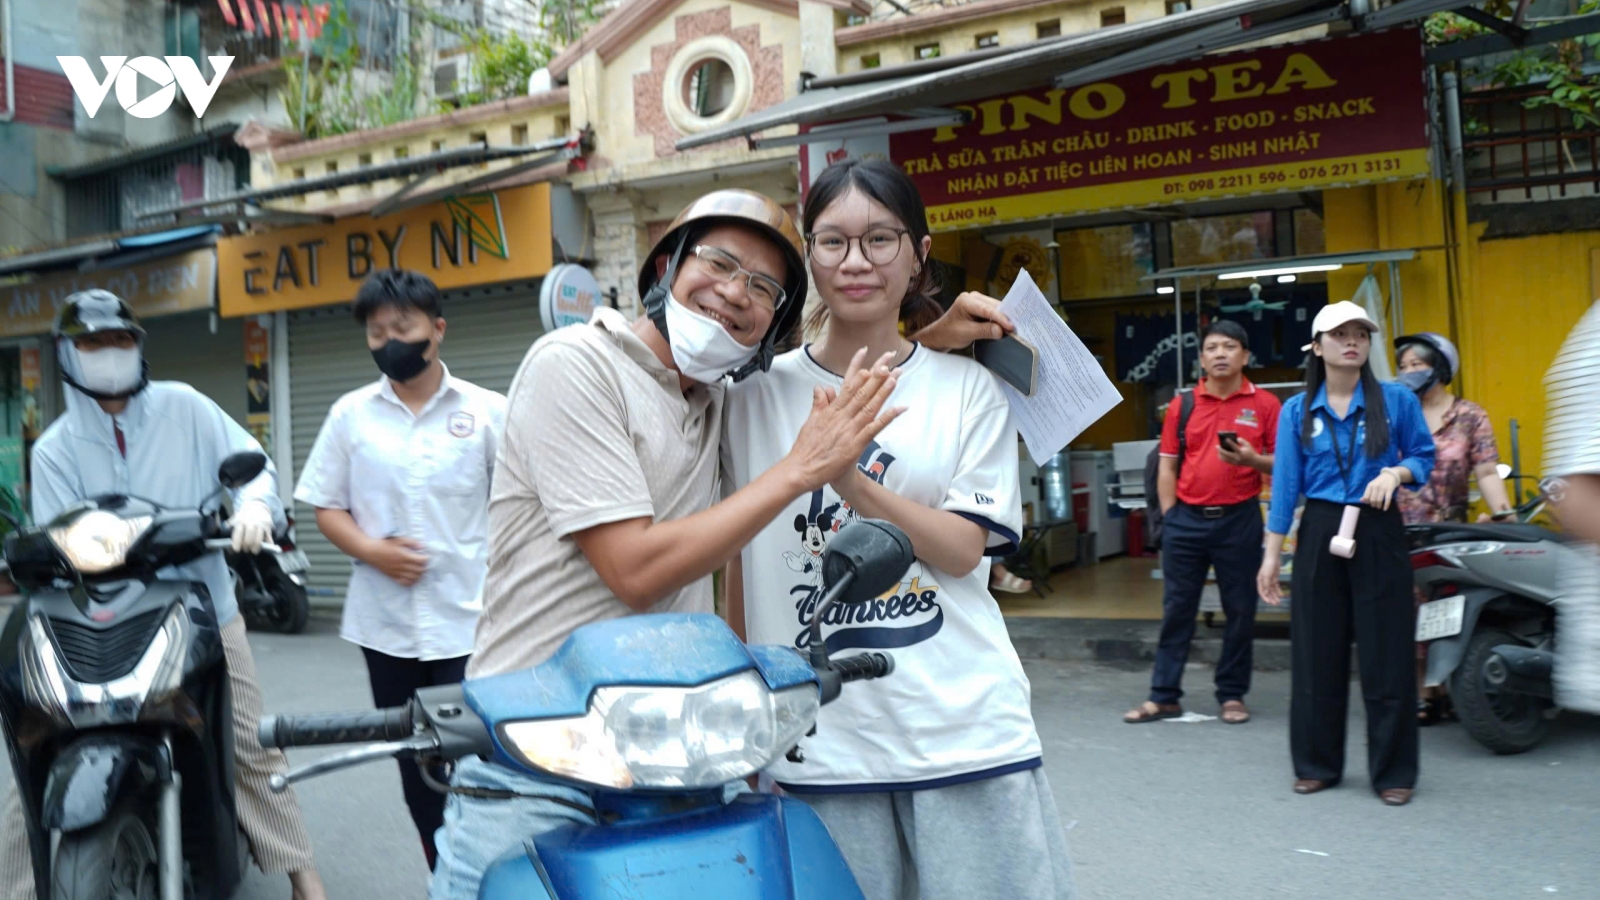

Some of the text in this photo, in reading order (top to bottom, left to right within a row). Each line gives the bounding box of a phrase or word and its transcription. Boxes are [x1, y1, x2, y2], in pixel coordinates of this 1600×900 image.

[1151, 53, 1338, 109] TEA
[903, 152, 943, 176] TRÀ
[947, 148, 987, 169] SỮA
[991, 139, 1047, 163] TRÂN
[1052, 132, 1110, 155] CHÂU
[1127, 120, 1197, 145] DRINK
[1214, 109, 1276, 133] FOOD
[1293, 97, 1376, 123] SNACK
[947, 173, 999, 195] NHẬN
[1003, 166, 1039, 189] ĐẶT
[1044, 160, 1083, 184] TIỆC
[1089, 154, 1127, 176] LIÊN
[1133, 148, 1192, 171] HOAN
[1209, 141, 1257, 161] SINH
[1264, 131, 1321, 155] NHẬT
[1163, 182, 1185, 195] ĐT:
[1188, 178, 1214, 192] 098
[1219, 174, 1253, 188] 2211
[1259, 171, 1286, 184] 596
[1299, 165, 1327, 180] 076
[1331, 162, 1358, 175] 271
[1364, 157, 1401, 172] 3131
[243, 239, 325, 295] EAT
[346, 225, 407, 280] BY
[790, 584, 938, 649] Yankees
